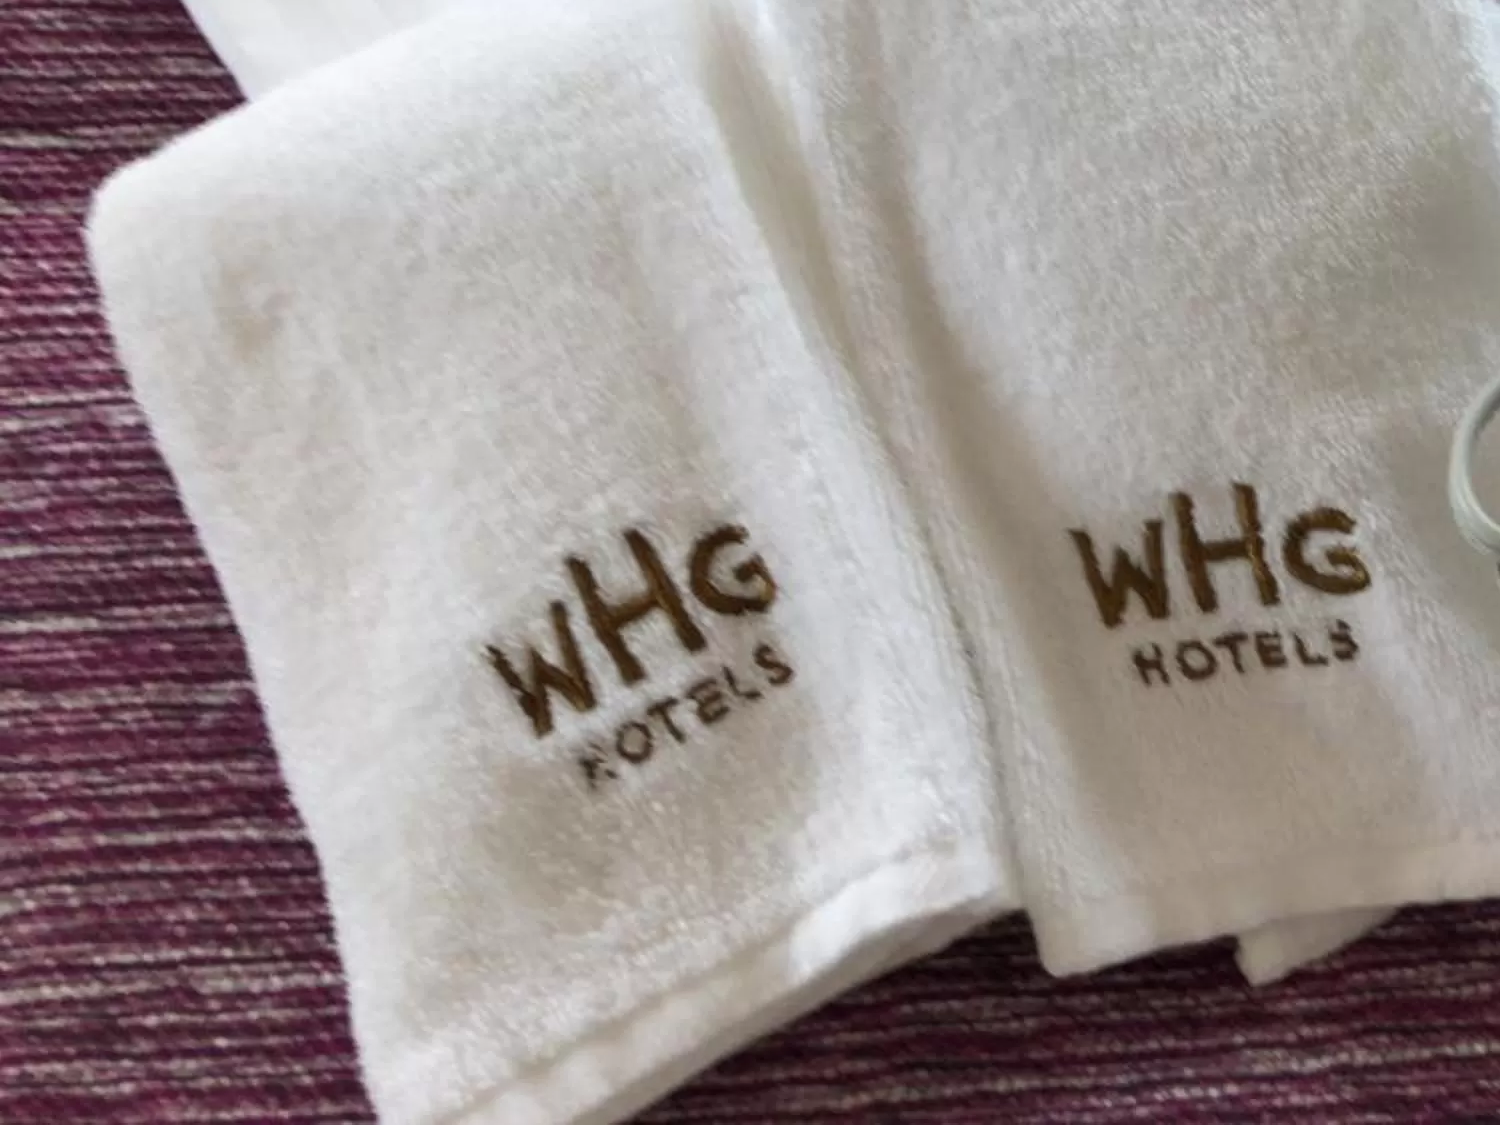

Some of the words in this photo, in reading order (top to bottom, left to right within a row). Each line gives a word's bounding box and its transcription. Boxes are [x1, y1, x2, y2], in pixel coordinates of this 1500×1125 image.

[1066, 480, 1372, 630] WHG
[485, 524, 777, 740] WHG
[1131, 619, 1359, 687] HOTELS
[578, 643, 796, 792] HOTELS
